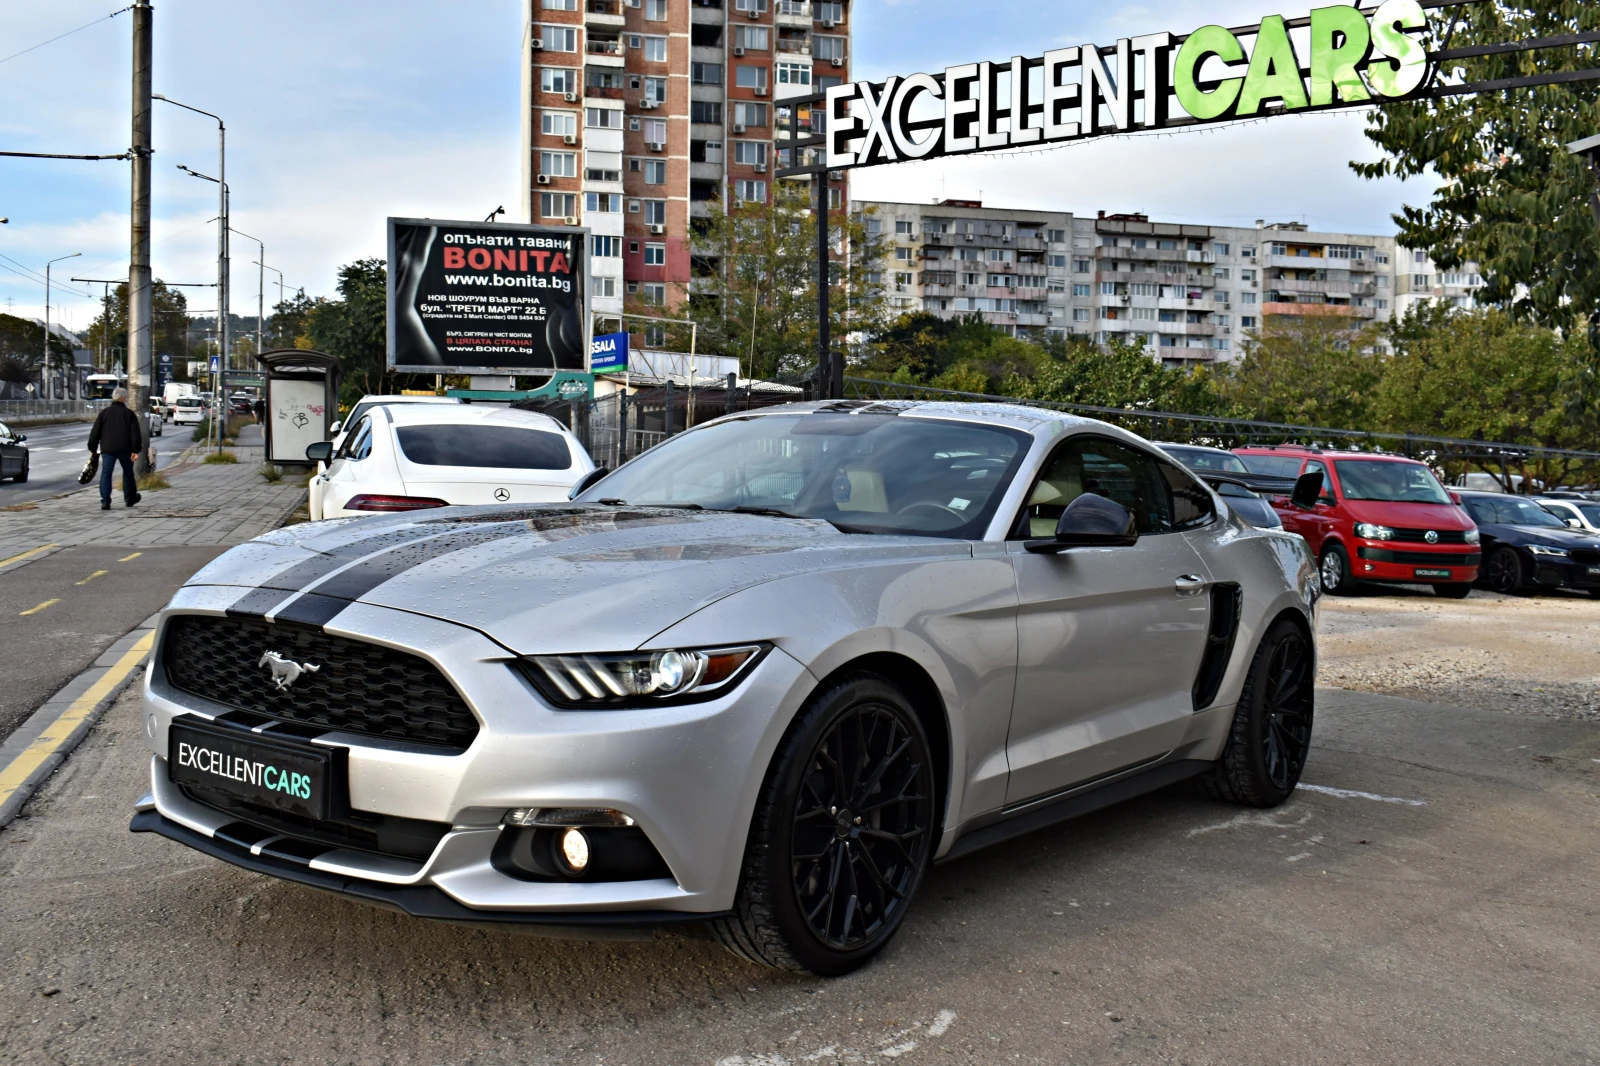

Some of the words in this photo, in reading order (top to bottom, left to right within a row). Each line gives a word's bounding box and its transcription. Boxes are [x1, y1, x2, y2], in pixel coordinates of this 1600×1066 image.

[443, 233, 514, 246] опънати
[517, 236, 571, 250] тавани
[443, 246, 570, 274] BONITA
[444, 273, 571, 292] www.bonita.bg
[427, 294, 447, 302] НОВ
[448, 295, 487, 303] ШОУРУМ
[488, 296, 509, 304] ВЪВ
[510, 297, 540, 305] ВАРНА
[420, 303, 443, 313] бул.
[524, 306, 537, 315] 22
[539, 306, 547, 315] Б
[447, 346, 533, 354] www.BONITA.bg
